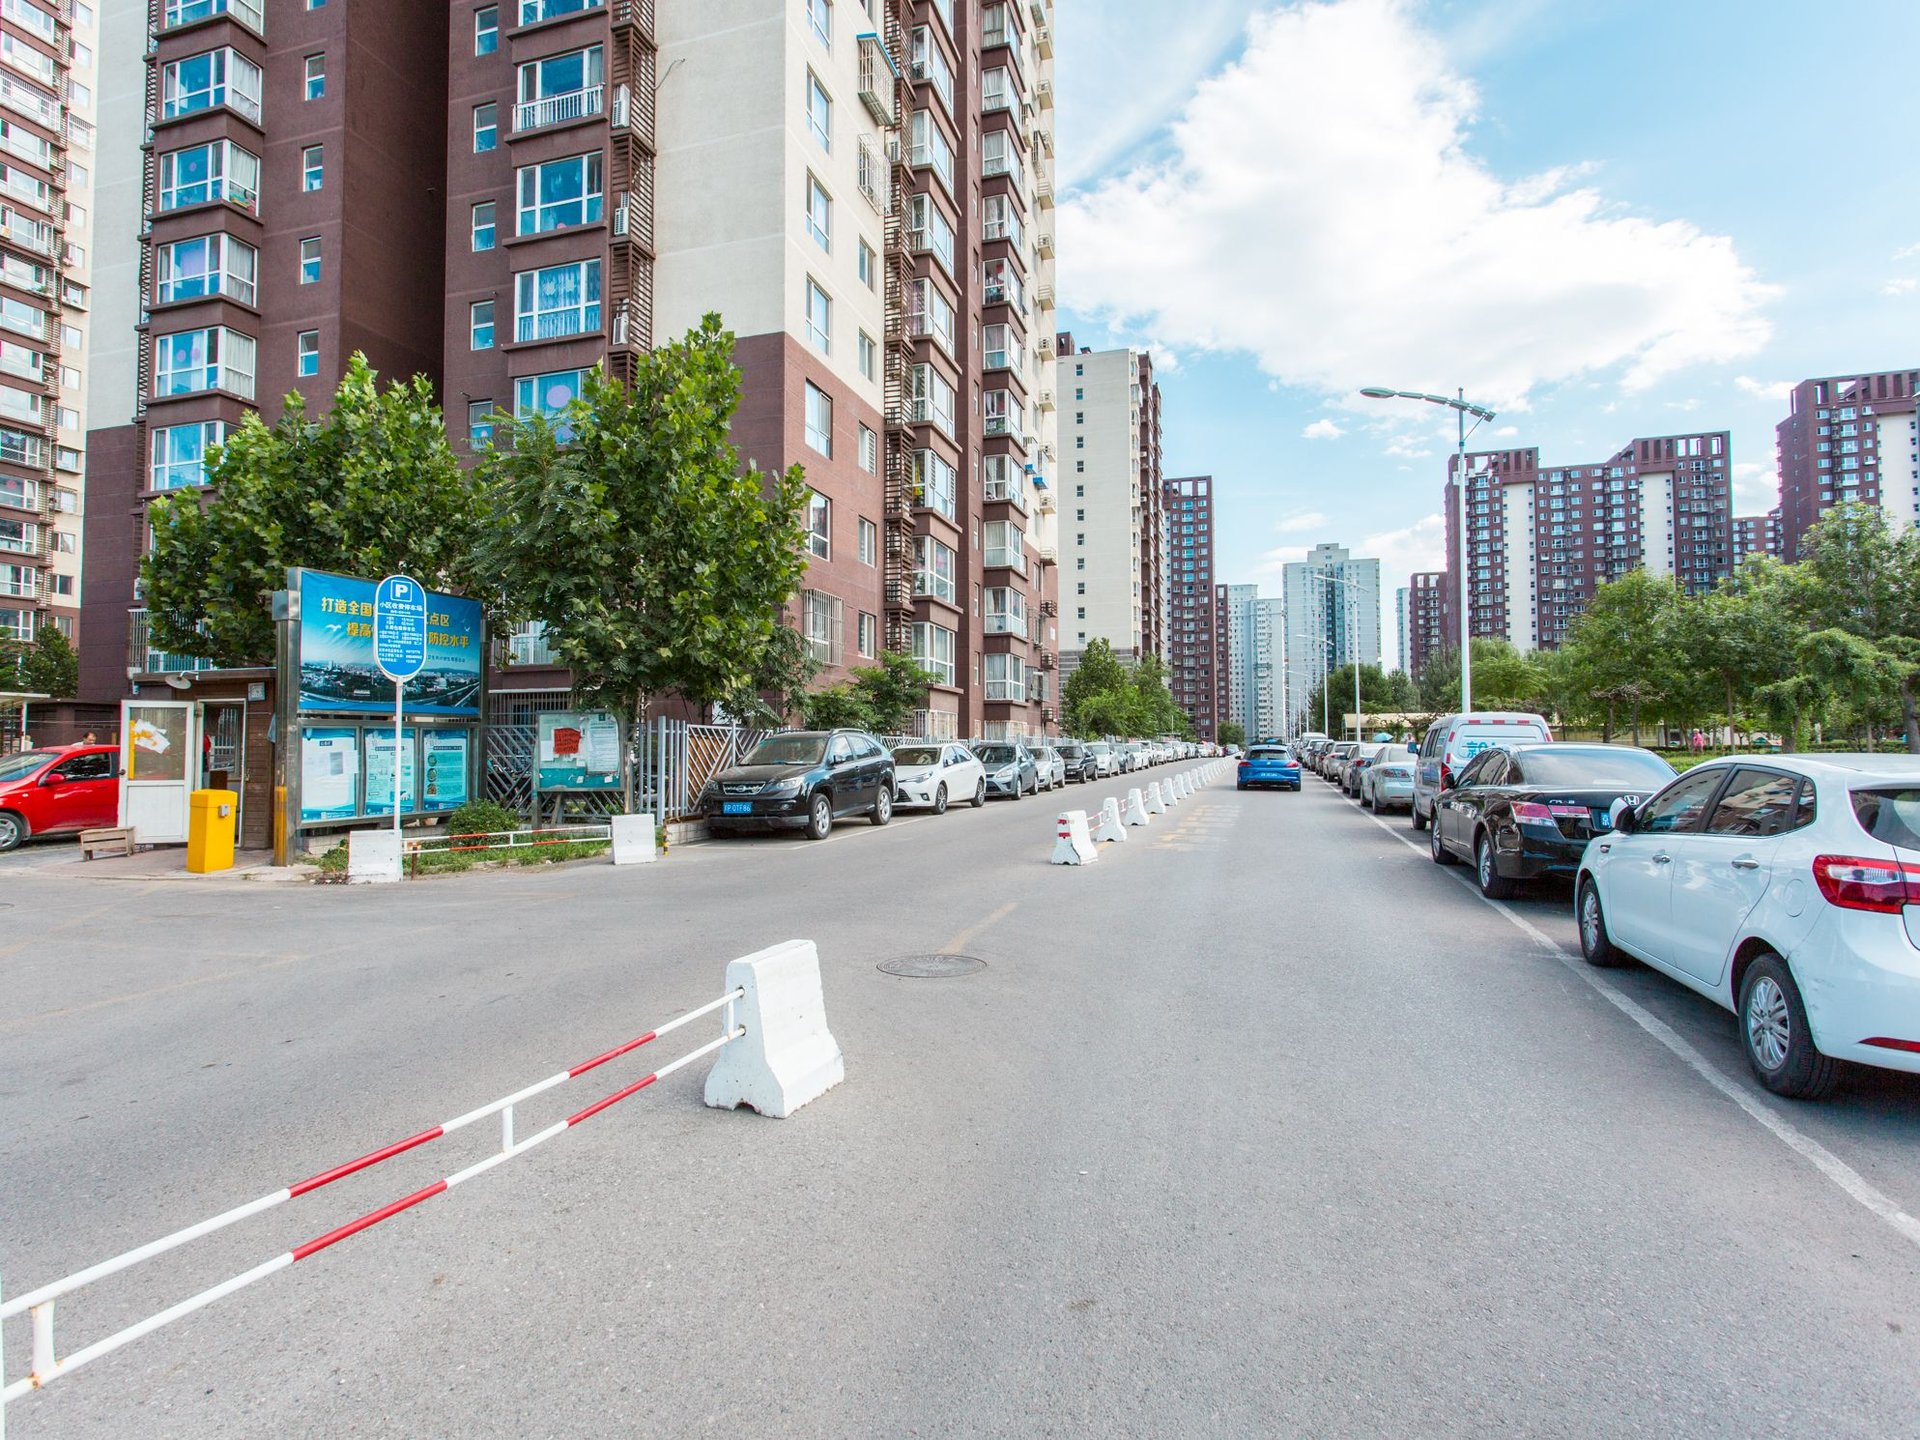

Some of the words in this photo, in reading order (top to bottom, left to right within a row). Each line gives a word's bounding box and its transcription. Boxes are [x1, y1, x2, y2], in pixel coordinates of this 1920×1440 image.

[395, 584, 408, 597] P
[321, 597, 373, 617] 打造全国
[426, 611, 450, 627] 点区
[428, 632, 468, 648] 防控水平
